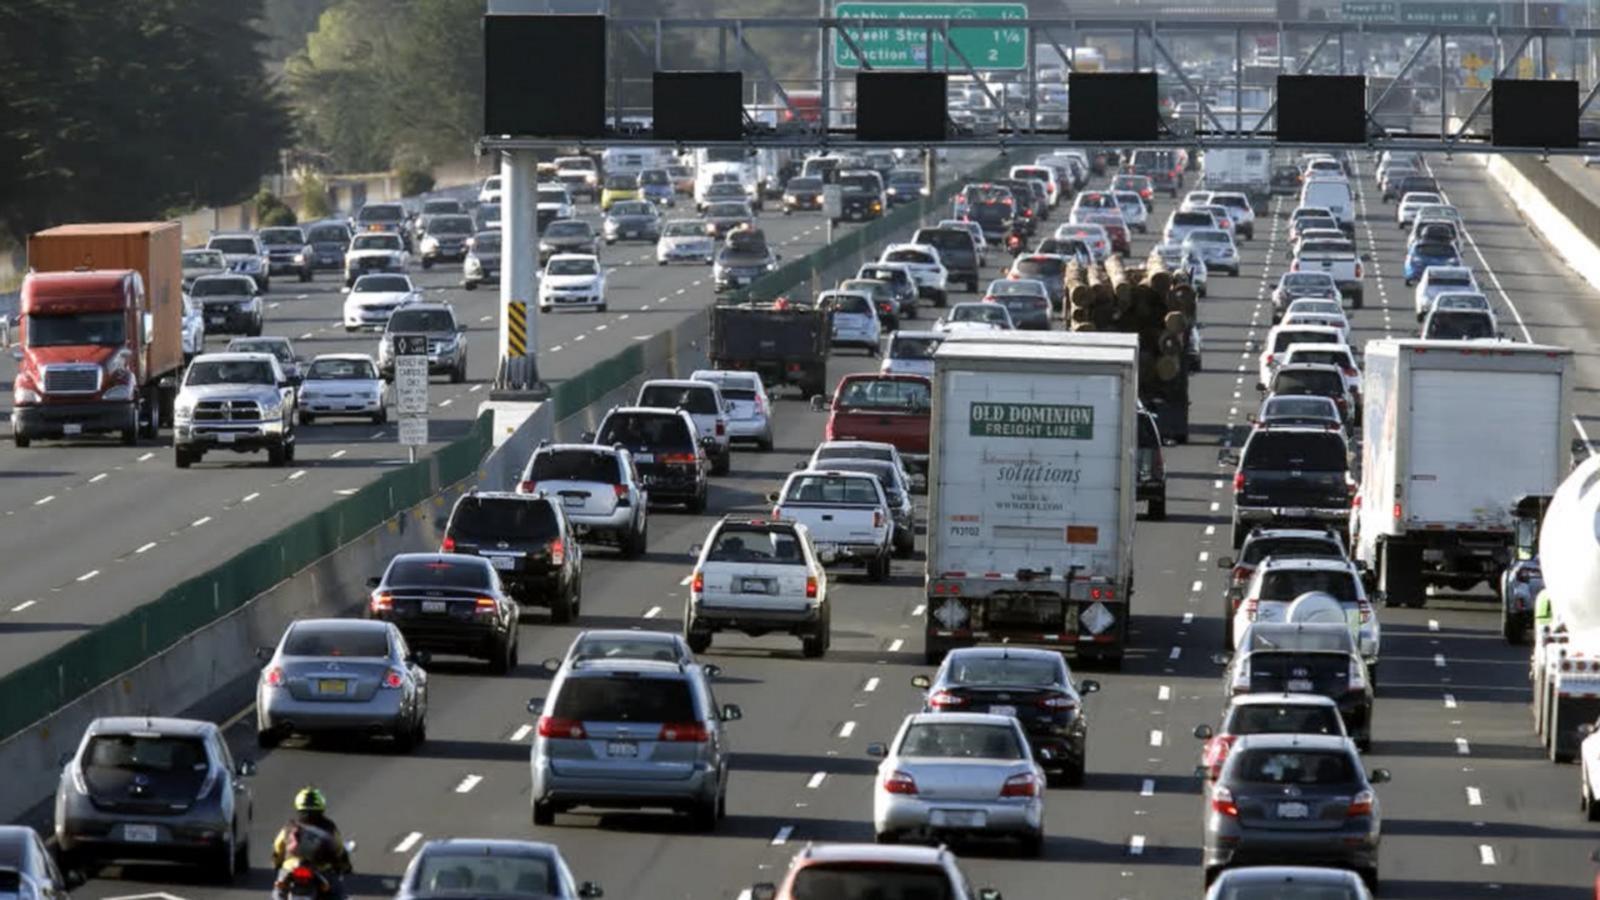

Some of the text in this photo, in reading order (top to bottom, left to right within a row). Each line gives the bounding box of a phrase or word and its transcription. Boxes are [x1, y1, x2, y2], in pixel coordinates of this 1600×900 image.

[987, 48, 999, 61] 2
[973, 404, 1092, 425] OLD DOMINION
[985, 423, 1077, 437] FREIGHT LINE
[997, 460, 1081, 484] solutions
